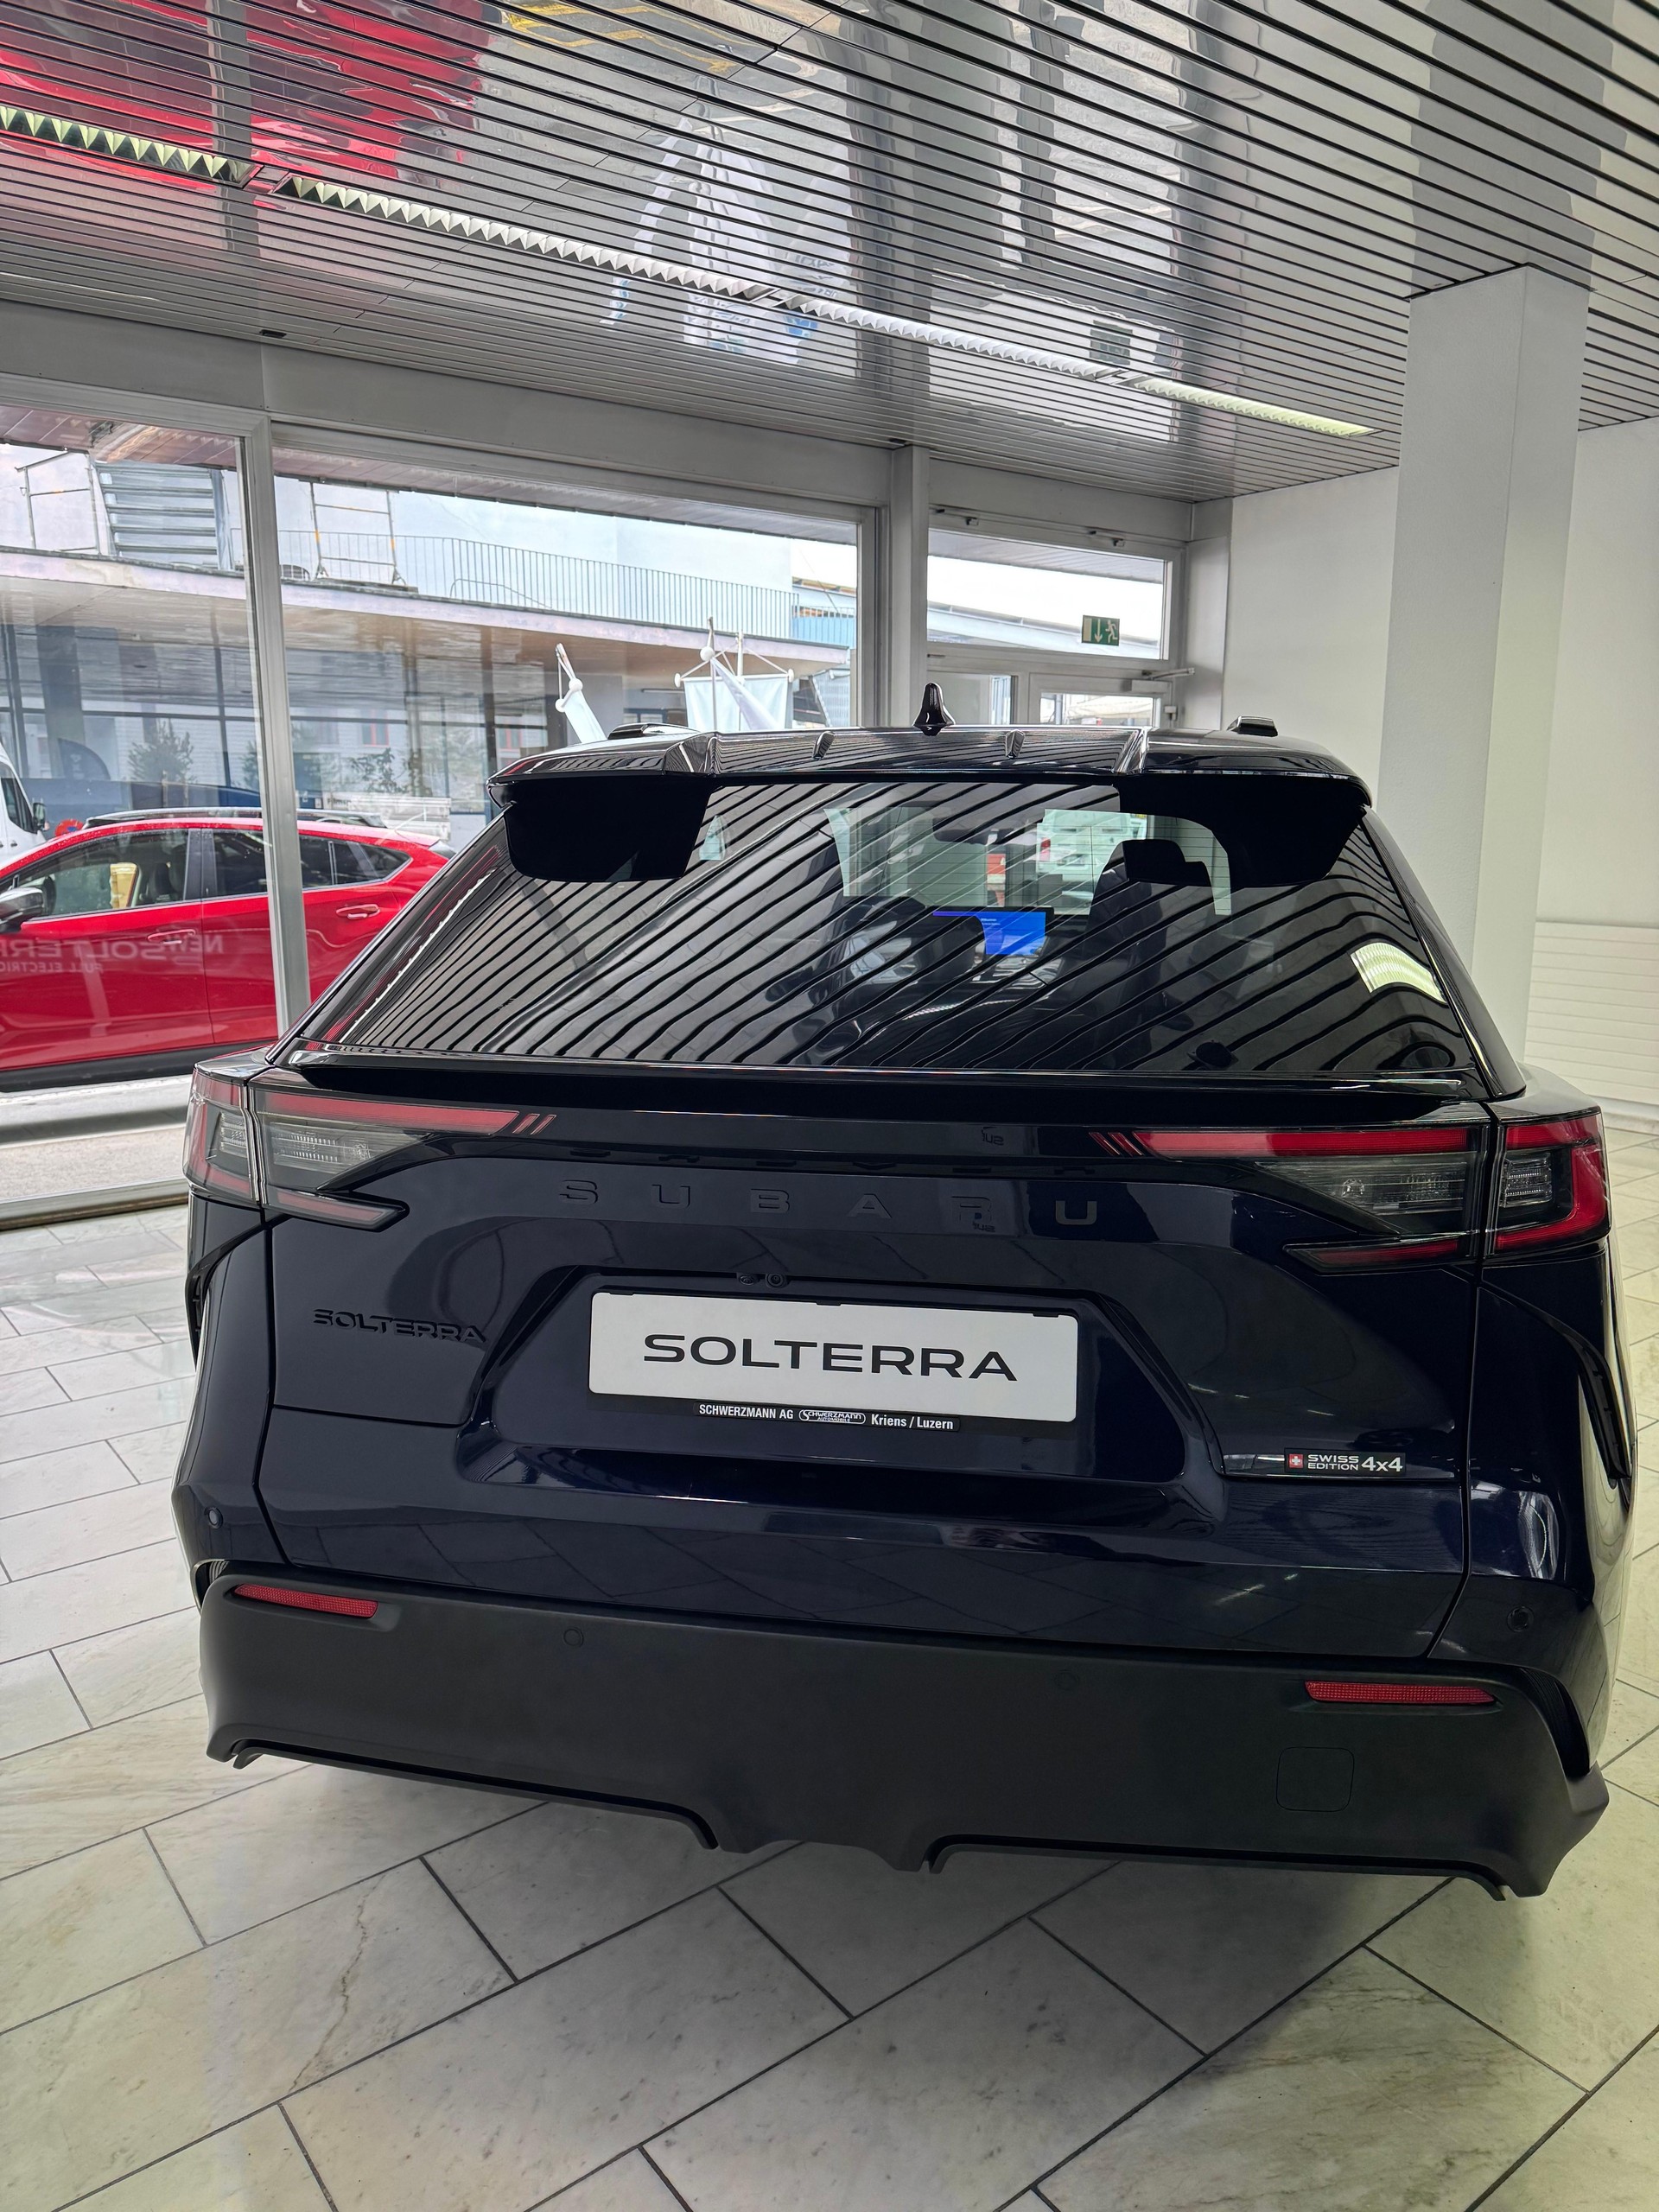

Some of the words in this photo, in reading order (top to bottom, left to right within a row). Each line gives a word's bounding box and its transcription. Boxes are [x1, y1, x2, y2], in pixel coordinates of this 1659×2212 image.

[558, 1179, 1098, 1226] SUBARU
[313, 1308, 487, 1344] SOLTERRA
[643, 1333, 1018, 1382] SOLTERRA
[698, 1404, 777, 1420] SCHWERZMANN
[779, 1408, 794, 1420] AG
[871, 1414, 907, 1427] Kriens
[916, 1416, 954, 1430] Luzern
[1307, 1454, 1359, 1464] SWISS
[1361, 1456, 1403, 1472] 4x4
[1307, 1462, 1359, 1471] EDITION
